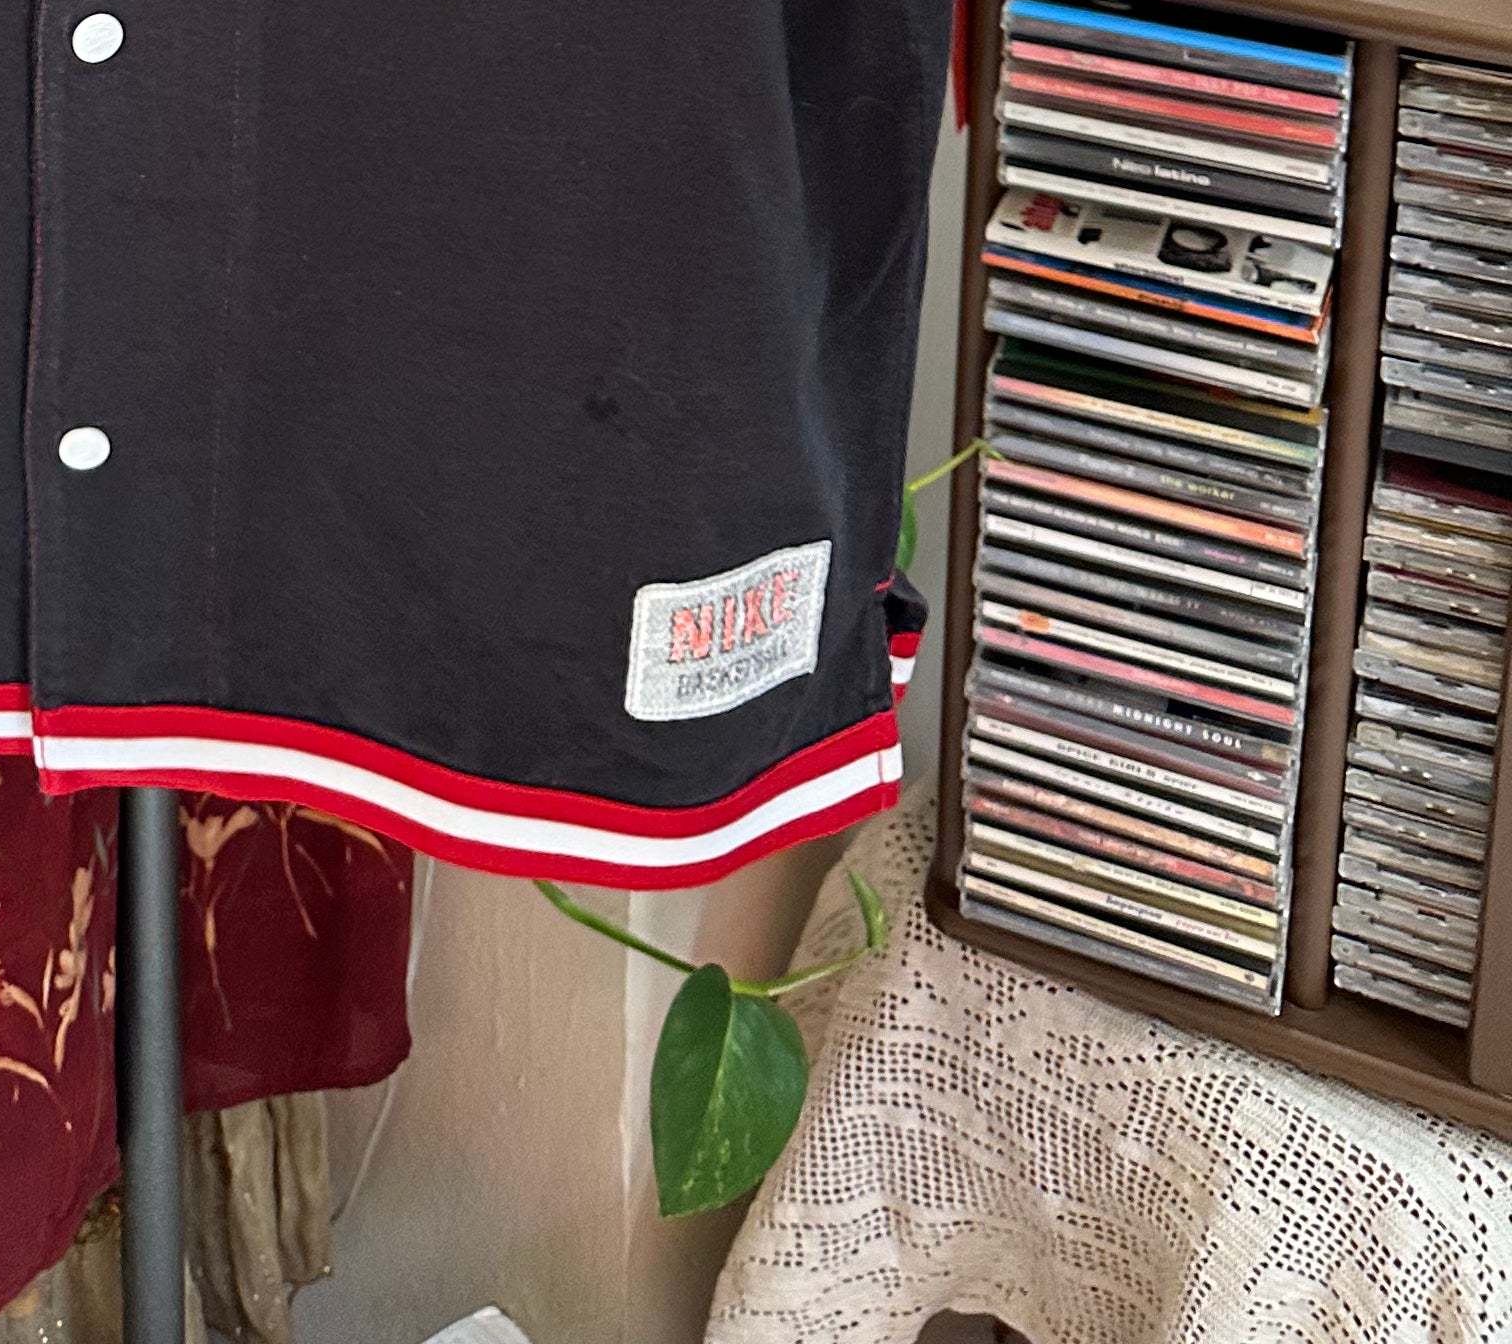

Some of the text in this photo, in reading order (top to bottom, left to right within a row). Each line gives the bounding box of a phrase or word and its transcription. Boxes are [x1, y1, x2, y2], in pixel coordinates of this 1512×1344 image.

[1155, 163, 1211, 187] latino
[1187, 478, 1236, 501] worker
[667, 569, 799, 664] NIKE
[1113, 703, 1244, 750] MIDNIGHT SOUL
